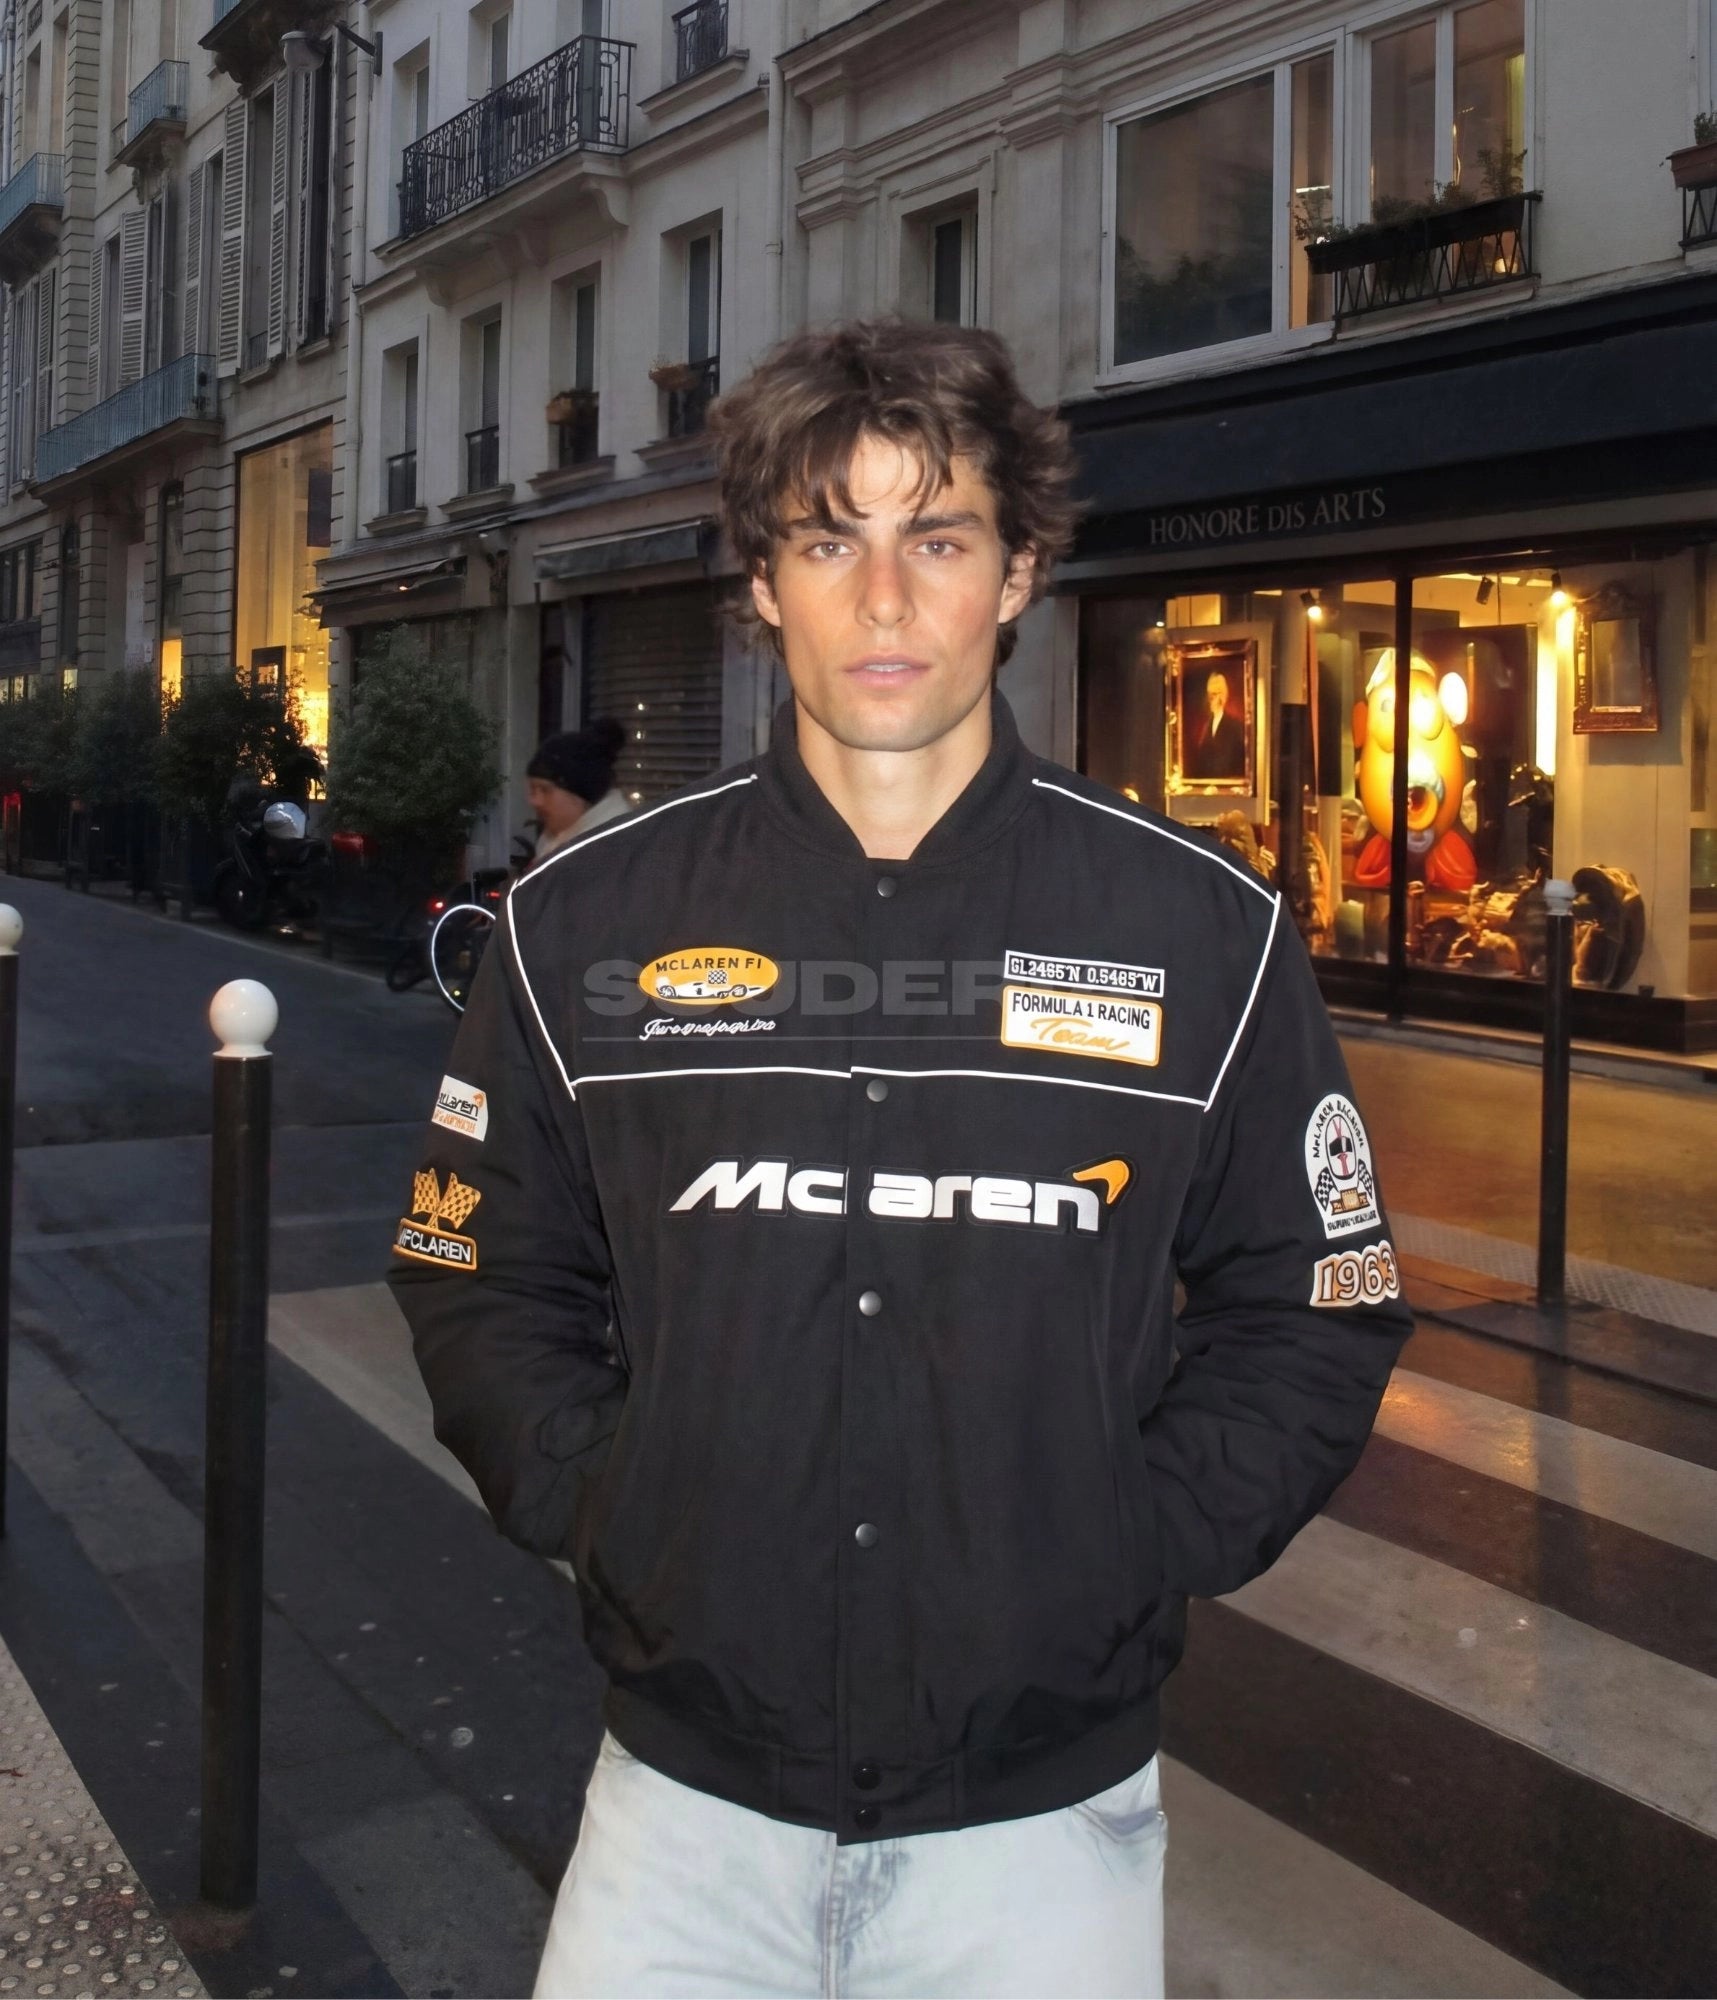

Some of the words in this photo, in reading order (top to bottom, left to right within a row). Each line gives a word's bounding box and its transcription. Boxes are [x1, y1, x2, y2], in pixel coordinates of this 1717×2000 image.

[1150, 505, 1259, 544] HONORE
[1268, 502, 1305, 532] DIS
[1312, 487, 1386, 526] ARTS
[656, 957, 739, 973] MCLAREN
[1012, 992, 1082, 1018] FORMULA
[1087, 1003, 1094, 1018] 1
[1098, 1003, 1150, 1030] RACING
[1030, 1017, 1130, 1051] Team
[1316, 1246, 1399, 1303] 1963
